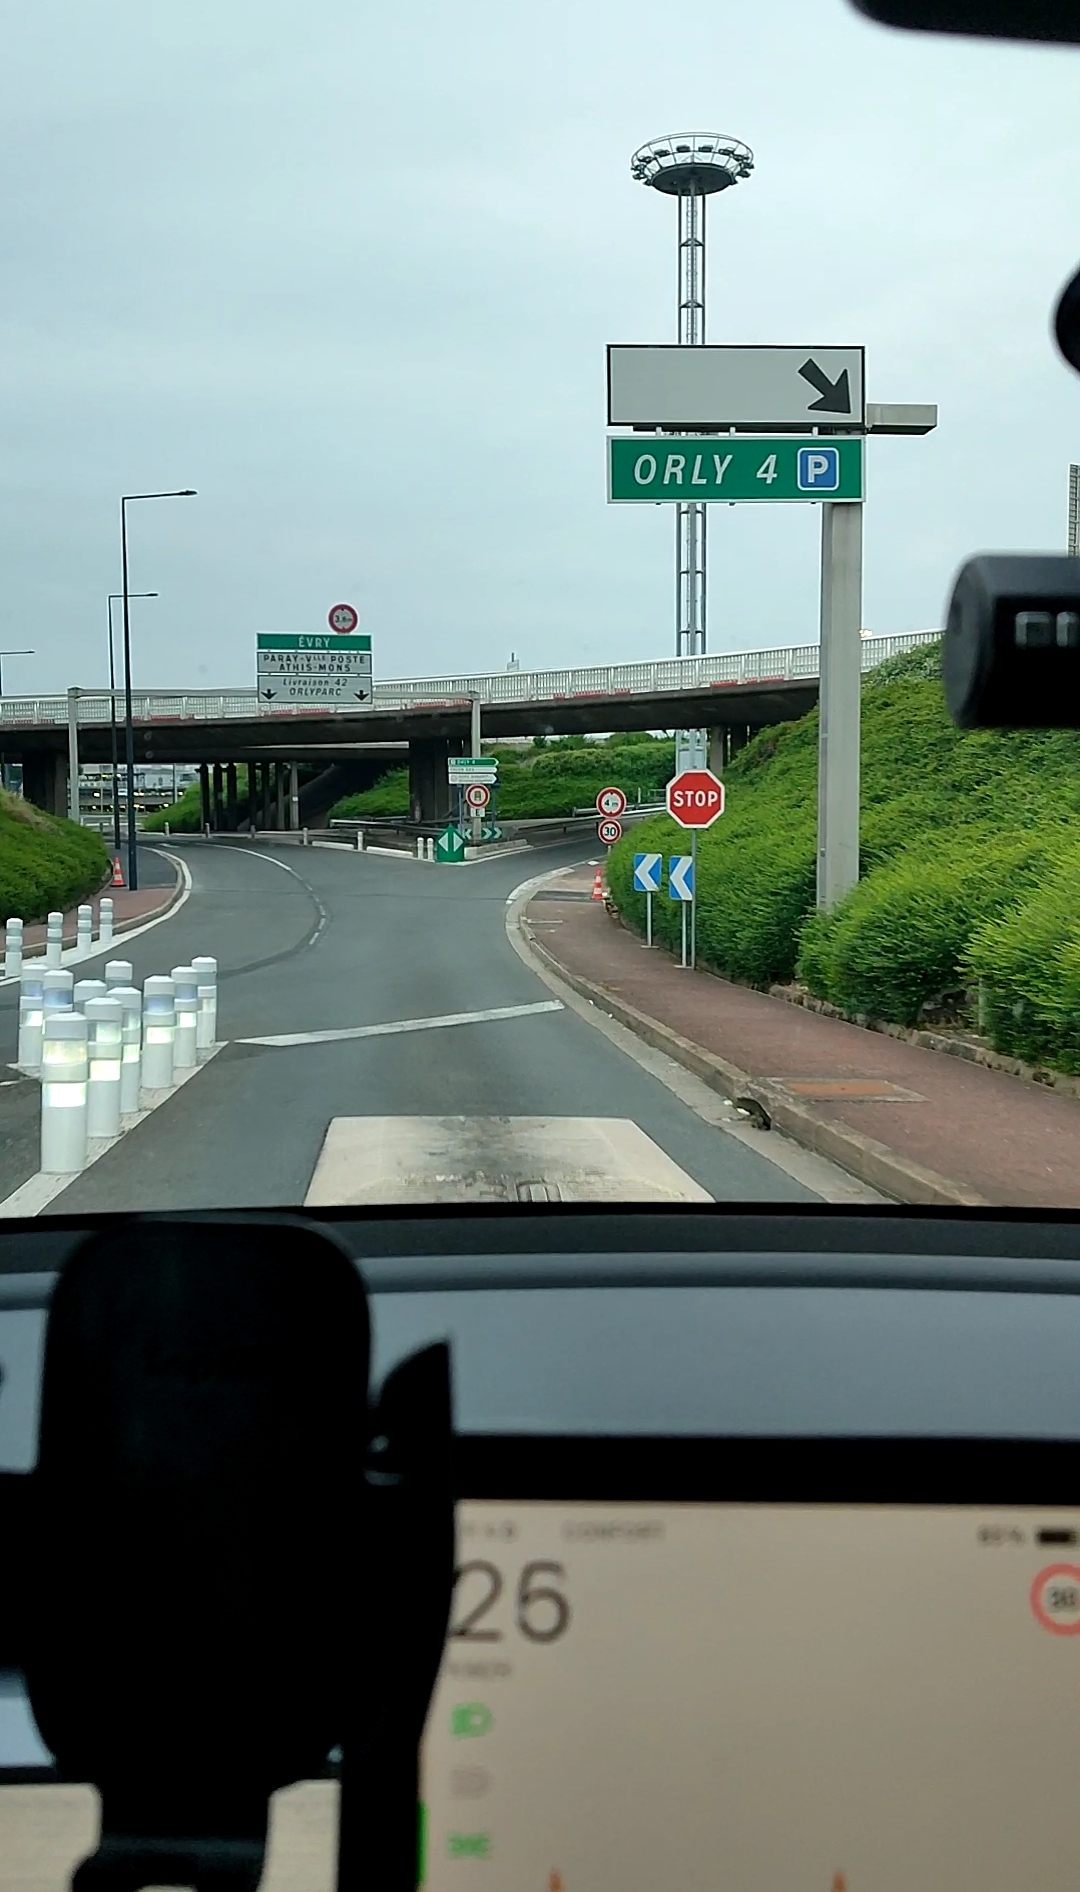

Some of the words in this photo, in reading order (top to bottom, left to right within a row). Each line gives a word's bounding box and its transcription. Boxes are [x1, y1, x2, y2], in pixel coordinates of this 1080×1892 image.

[633, 454, 733, 485] ORLY
[756, 454, 778, 484] 4
[807, 455, 829, 483] P
[298, 635, 331, 648] ÉVRY
[330, 655, 365, 664] POSTE
[279, 663, 351, 672] ATHIS-MONS
[283, 678, 330, 687] Livraison
[334, 678, 348, 687] 42
[289, 687, 342, 696] ORLYPARC
[673, 790, 718, 807] STOP
[604, 827, 616, 837] 30
[450, 1559, 571, 1645] 26
